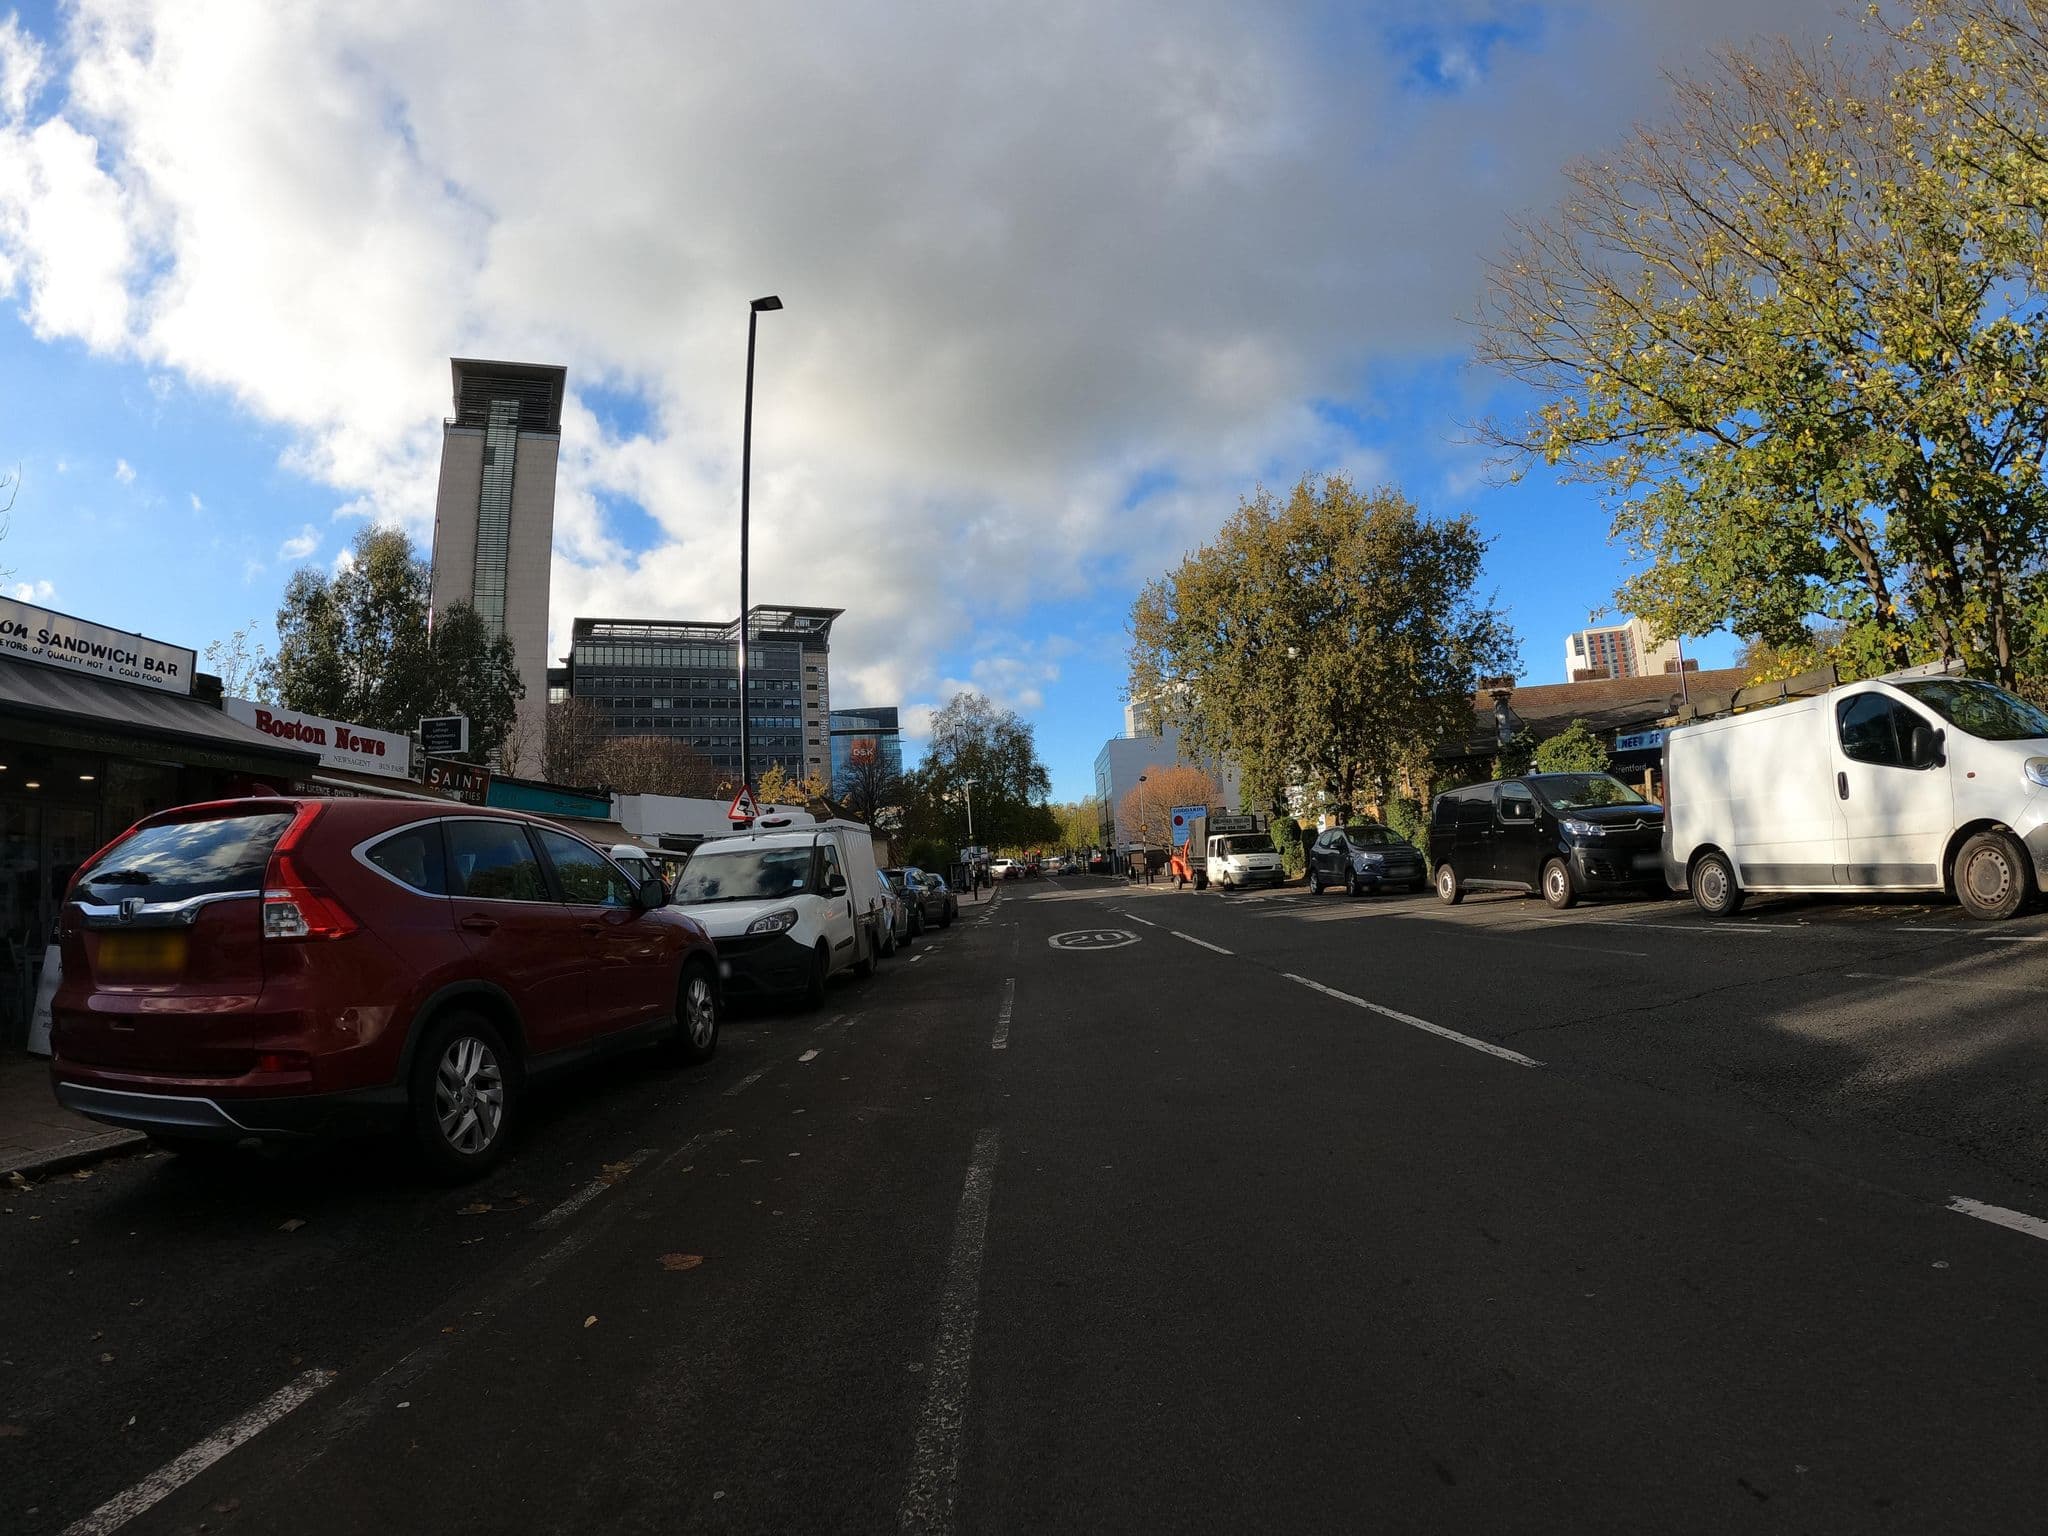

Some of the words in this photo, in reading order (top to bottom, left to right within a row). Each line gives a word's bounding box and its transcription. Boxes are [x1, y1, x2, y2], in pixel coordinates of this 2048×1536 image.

[32, 646, 44, 655] OF
[47, 650, 83, 665] QUALITY
[87, 660, 104, 670] HOT
[108, 665, 114, 673] &
[119, 667, 140, 679] COLD
[142, 672, 163, 684] FOOD
[37, 628, 138, 667] SANDWICH
[143, 656, 178, 676] BAR
[818, 666, 827, 690] Great
[819, 695, 829, 716] West
[255, 708, 326, 746] Boston
[335, 727, 386, 757] News
[820, 720, 829, 746] House
[430, 767, 483, 790] SAINT
